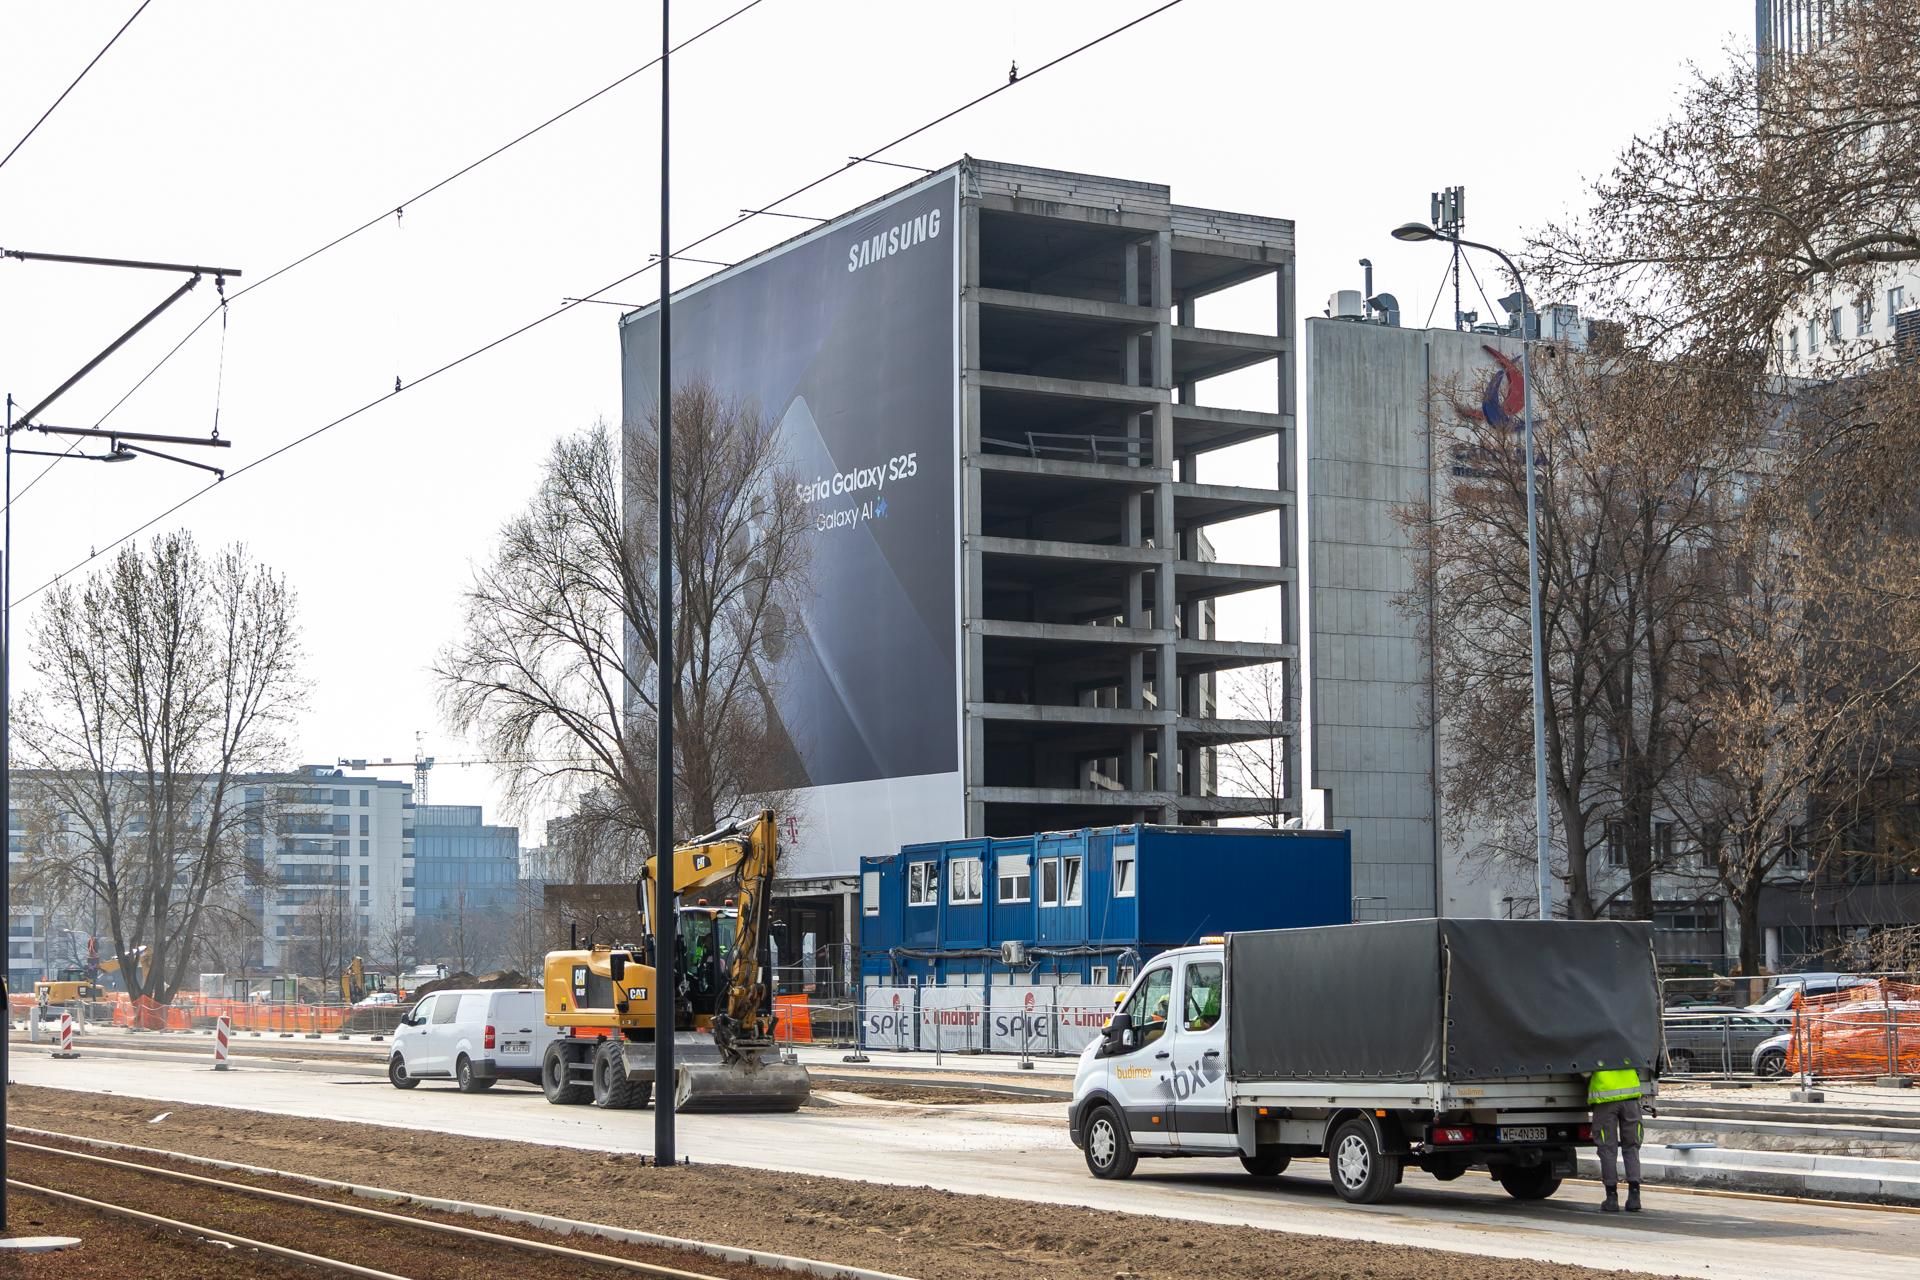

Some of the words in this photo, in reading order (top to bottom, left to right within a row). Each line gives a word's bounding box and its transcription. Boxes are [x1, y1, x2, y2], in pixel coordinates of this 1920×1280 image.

[848, 209, 940, 272] SAMSUNG
[796, 476, 830, 503] Seria
[832, 465, 887, 495] Galaxy
[889, 453, 917, 481] S25
[816, 508, 859, 531] Galaxy
[862, 501, 873, 520] AI
[697, 856, 705, 869] CAT
[575, 969, 586, 986] CAT
[629, 988, 646, 1000] CAT
[870, 1014, 909, 1036] SPIE
[995, 1016, 1049, 1037] SPIE
[1116, 1064, 1152, 1079] budimex
